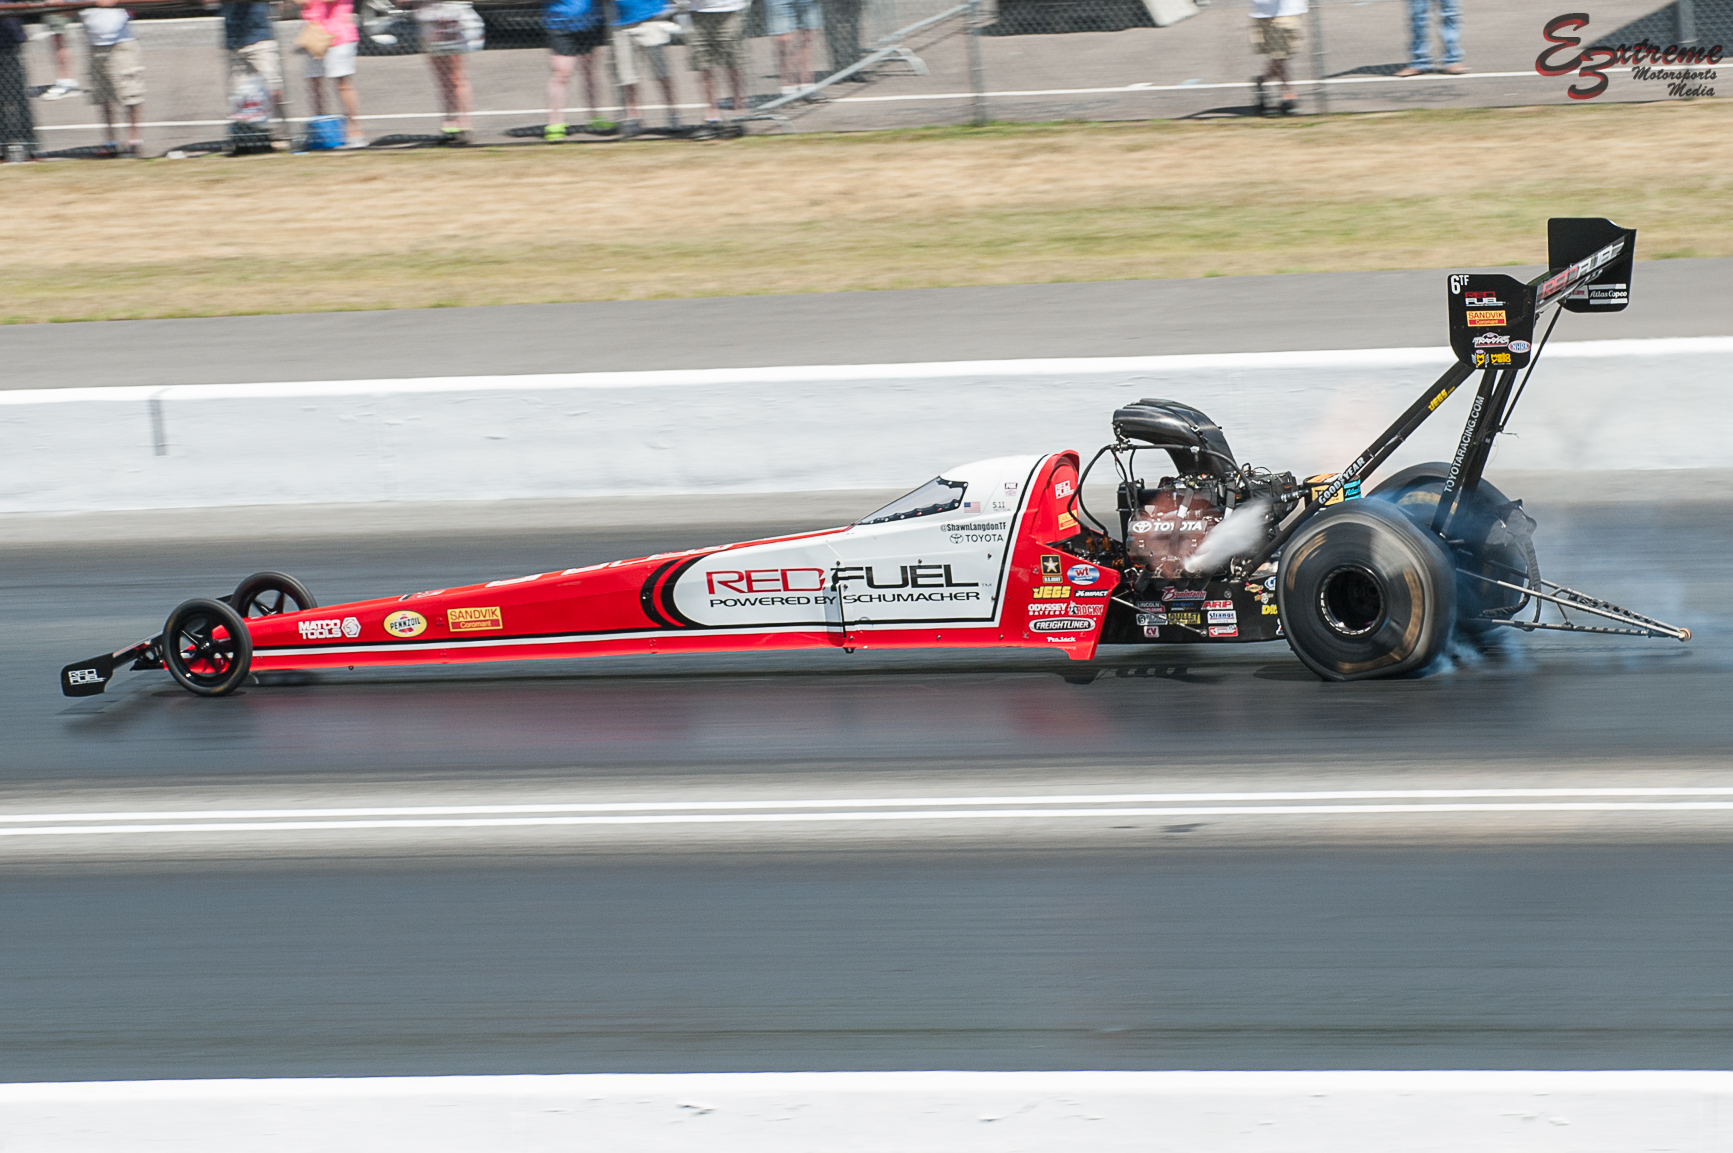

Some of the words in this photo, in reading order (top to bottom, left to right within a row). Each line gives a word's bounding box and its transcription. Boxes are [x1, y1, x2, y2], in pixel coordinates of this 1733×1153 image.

[1590, 290, 1608, 298] Atlas
[1608, 290, 1628, 298] Copco
[1468, 311, 1504, 319] SANDVIK
[1443, 395, 1485, 493] TOYOTARACING.COM
[993, 501, 1005, 509] 5.11
[940, 522, 1007, 532] @ShawnLangdonTF
[966, 534, 1004, 543] TOYOTA
[705, 567, 827, 595] RED
[829, 563, 980, 592] FUEL
[1032, 585, 1072, 599] JEGS
[709, 596, 811, 608] POWERED
[814, 595, 837, 605] BY
[842, 591, 981, 604] SCHUMACHER
[1202, 600, 1233, 609] ARP
[1027, 603, 1067, 611] ODYSSEY
[1076, 604, 1105, 616] ROCKY
[449, 608, 499, 621] SANDVIK
[1208, 611, 1235, 620] Strange
[298, 618, 342, 631] MATCO
[389, 616, 422, 631] PENNZOIL
[459, 620, 492, 630] Coromant
[1035, 620, 1090, 631] FREIGHTLINER
[300, 628, 342, 640] TOOLS
[1146, 627, 1157, 636] CV
[68, 668, 97, 677] RED
[69, 675, 106, 686] FUEL
